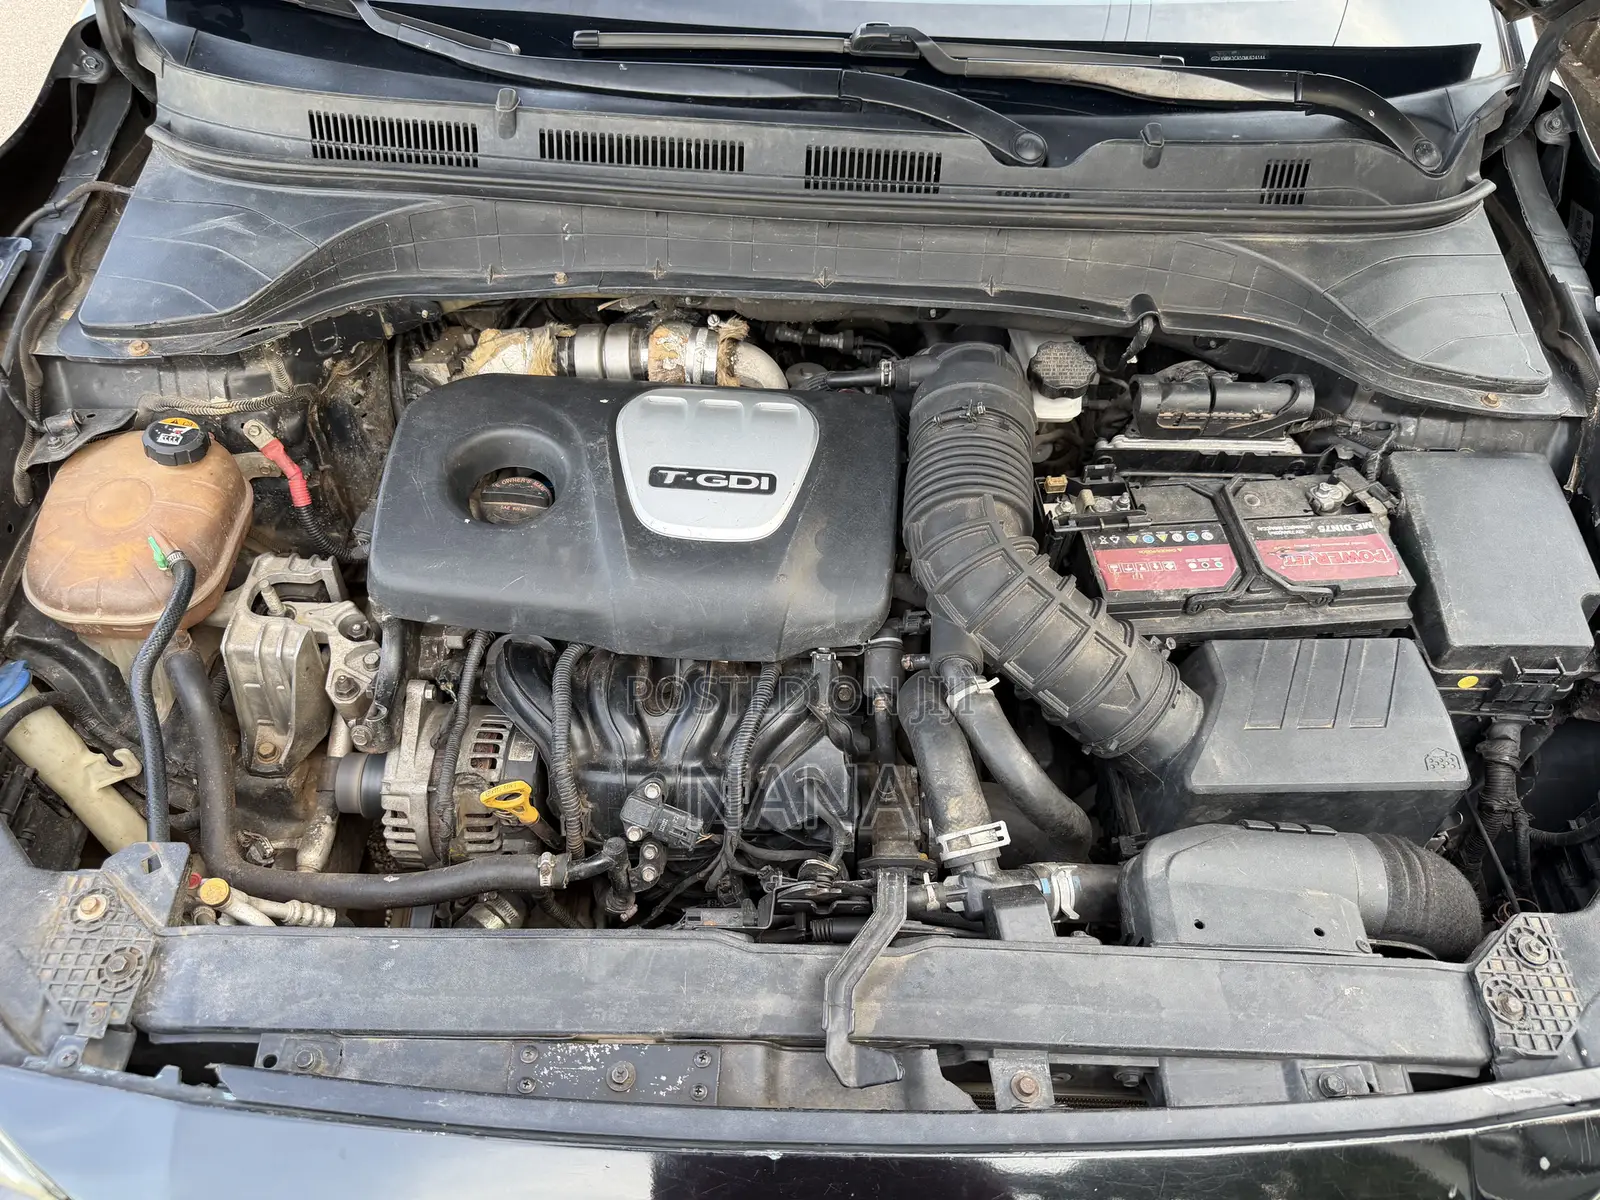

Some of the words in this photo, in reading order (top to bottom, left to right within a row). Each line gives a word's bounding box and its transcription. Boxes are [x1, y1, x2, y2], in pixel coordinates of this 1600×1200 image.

[658, 470, 770, 490] T-GDI
[1318, 523, 1354, 533] DIN75
[1355, 521, 1374, 531] MF
[1284, 553, 1316, 566] JET
[1315, 549, 1391, 565] POWER
